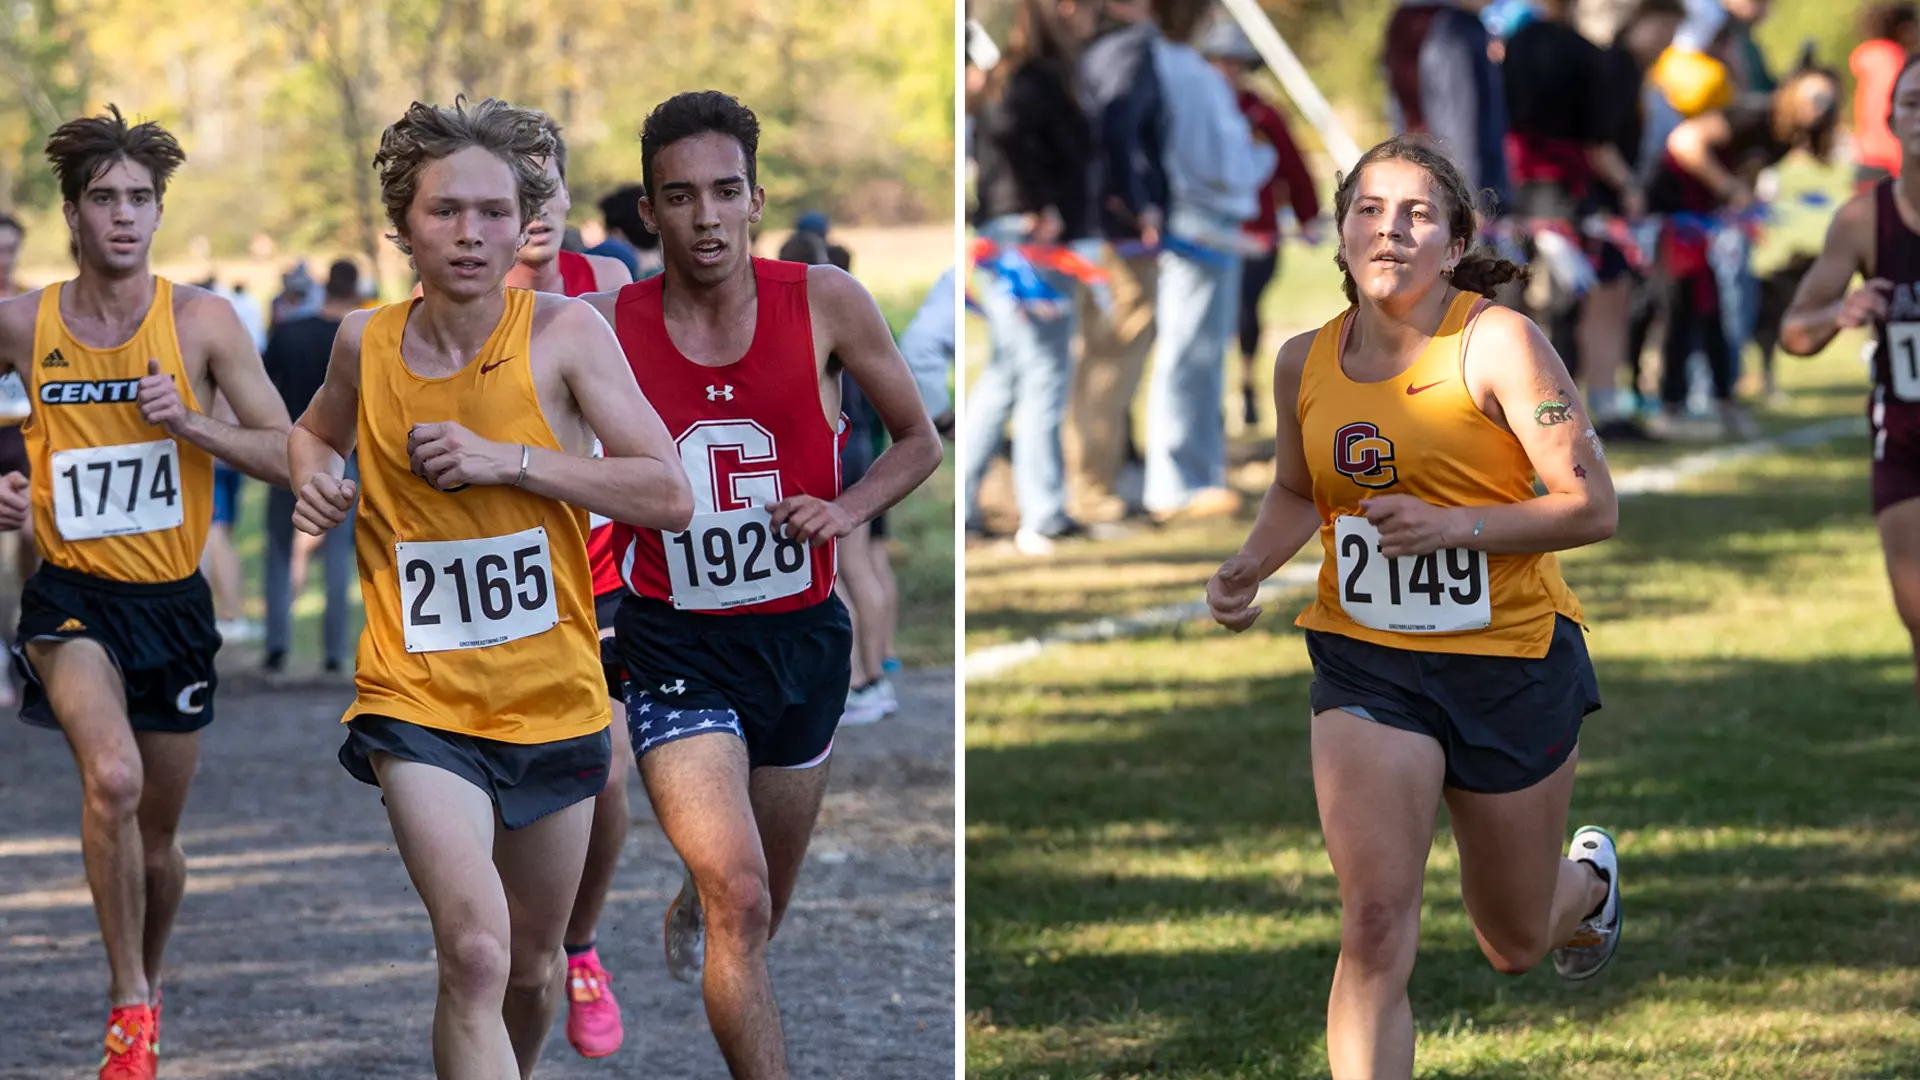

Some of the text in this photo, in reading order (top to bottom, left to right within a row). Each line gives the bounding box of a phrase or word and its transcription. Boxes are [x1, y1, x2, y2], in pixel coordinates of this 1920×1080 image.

[62, 453, 178, 518] 1774
[674, 418, 784, 514] G
[1334, 422, 1399, 489] CC
[405, 545, 548, 627] 2165
[673, 521, 805, 588] 1928
[1341, 533, 1482, 606] 2149
[176, 681, 208, 714] C
